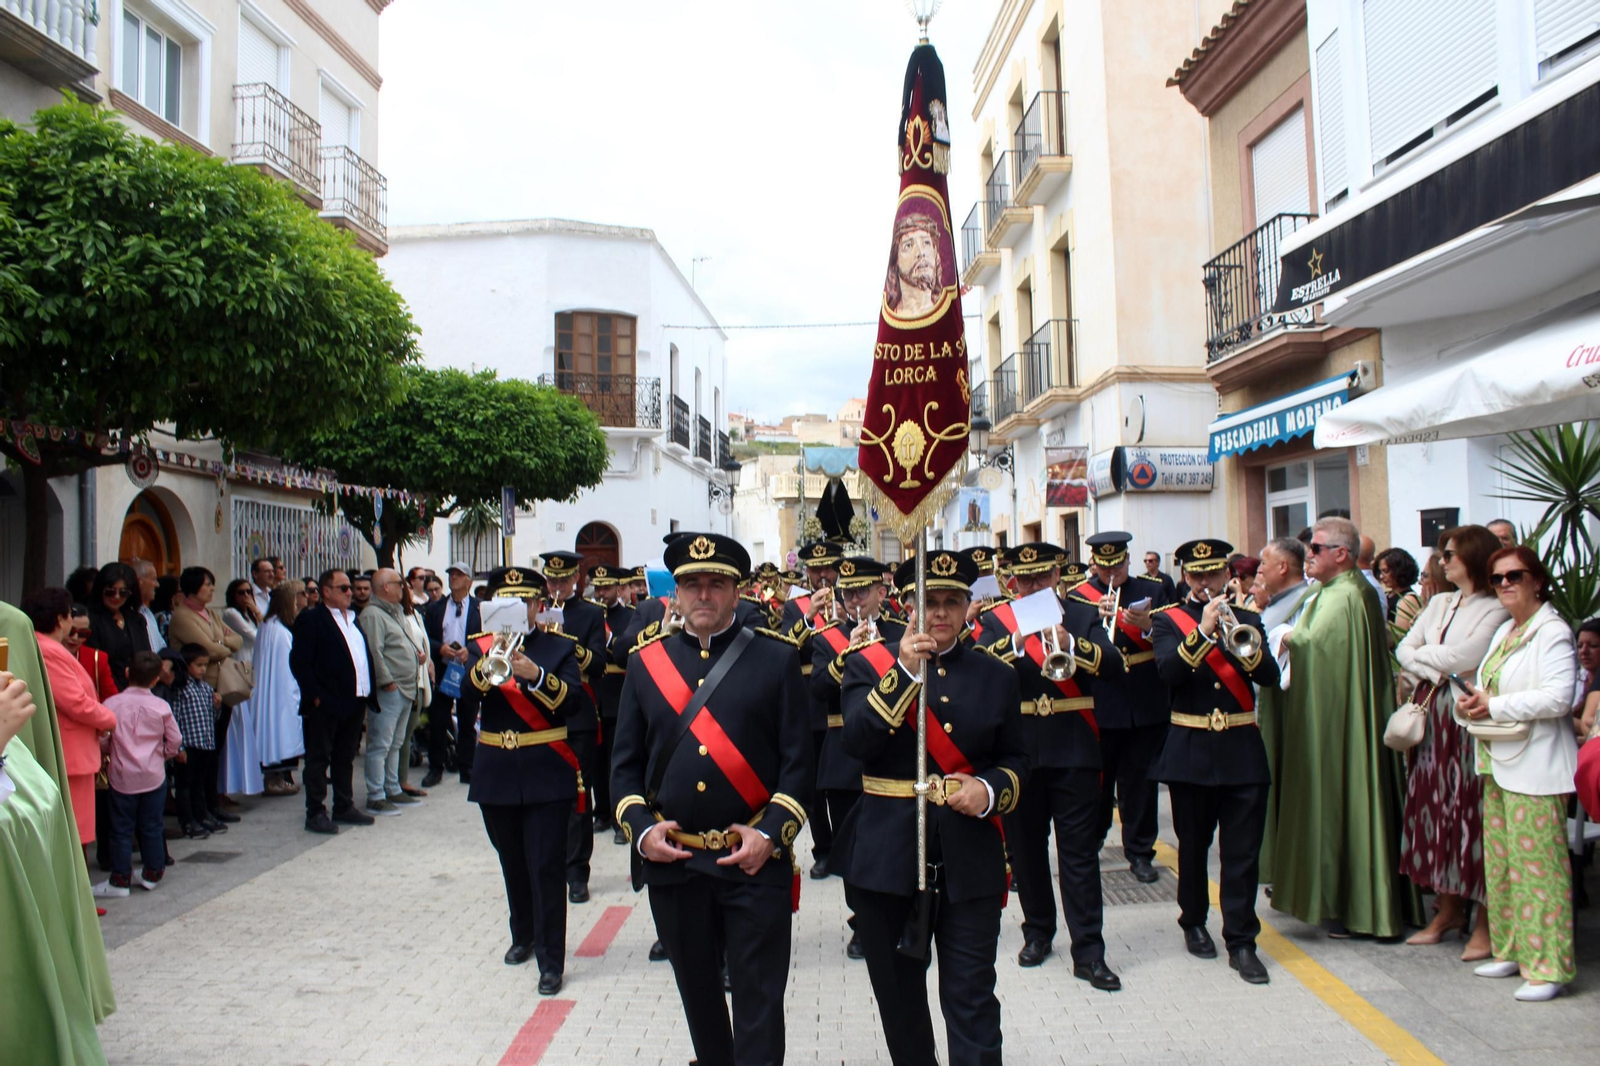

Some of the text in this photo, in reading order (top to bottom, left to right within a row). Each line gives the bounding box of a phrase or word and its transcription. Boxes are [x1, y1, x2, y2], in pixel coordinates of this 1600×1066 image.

[1291, 268, 1341, 301] ESTRELLA
[904, 343, 925, 361] DE
[929, 341, 953, 359] LA
[885, 365, 937, 386] LORCA
[1214, 416, 1279, 453] PESCADERIA
[1161, 472, 1212, 486] Telf. 647 397 249
